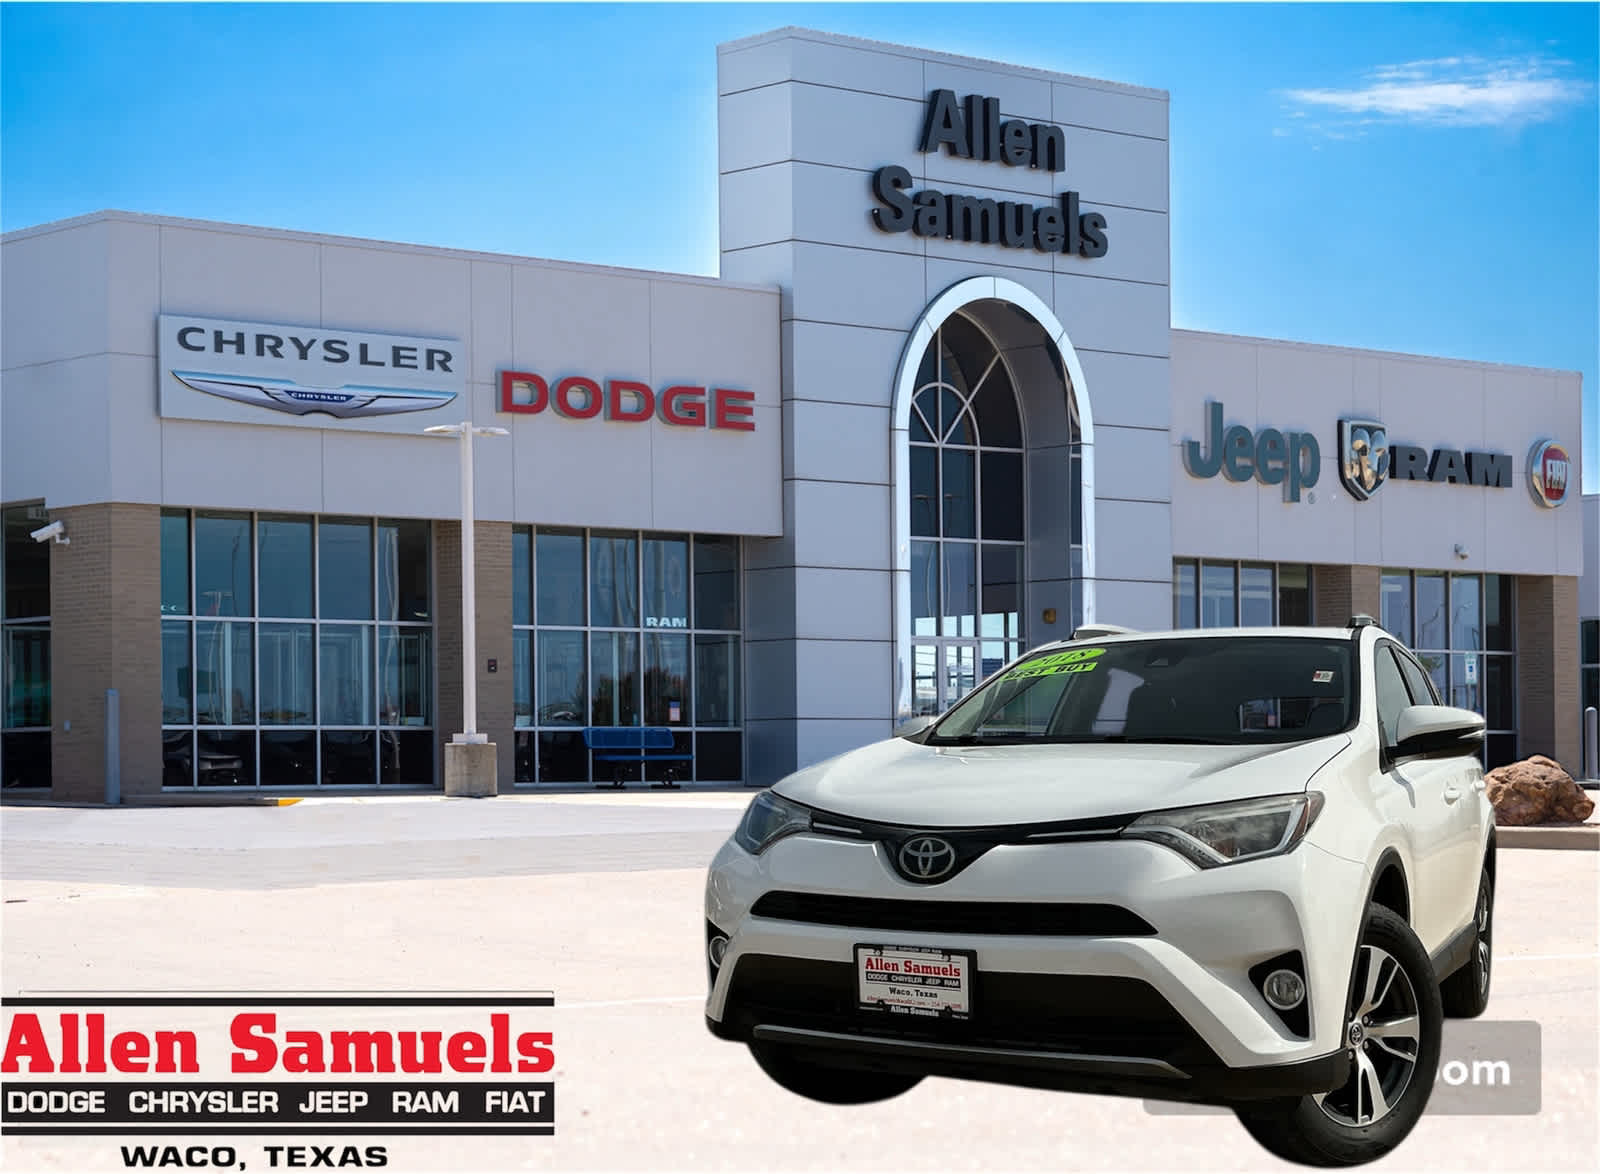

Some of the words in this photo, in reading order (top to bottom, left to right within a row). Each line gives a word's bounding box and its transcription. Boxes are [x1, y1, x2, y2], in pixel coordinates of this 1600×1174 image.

[918, 88, 1066, 172] Allen
[872, 165, 1109, 258] Samuels
[177, 326, 453, 372] CHRYSLER
[291, 392, 347, 401] CHRYSLER
[496, 370, 755, 432] DODGE
[1182, 401, 1321, 503] Jeep
[1390, 444, 1513, 488] RAM
[1544, 459, 1567, 490] FIAT
[646, 616, 687, 628] RAM
[1055, 662, 1088, 672] BUY
[865, 957, 899, 972] Allen
[904, 960, 961, 977] Samuels
[867, 972, 888, 981] DODGE
[891, 975, 922, 984] CHRYSLER
[926, 977, 941, 985] JEEP
[944, 979, 959, 987] RAM
[889, 987, 912, 997] Waco,
[915, 989, 938, 998] Texas
[891, 1005, 909, 1014] Allen
